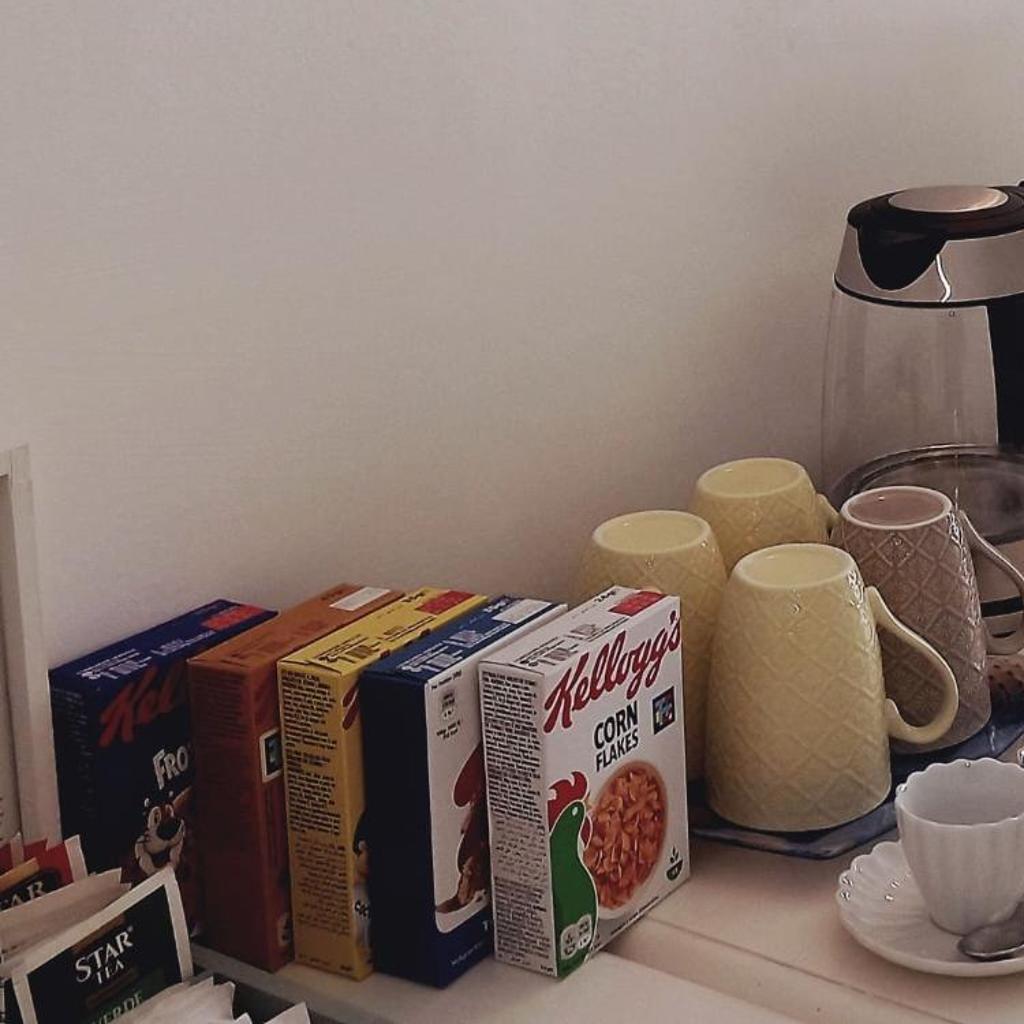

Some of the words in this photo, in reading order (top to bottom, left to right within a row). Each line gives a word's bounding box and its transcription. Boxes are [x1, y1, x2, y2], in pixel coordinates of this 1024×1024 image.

[543, 610, 681, 734] Kellogg's
[593, 701, 639, 750] CORN
[152, 742, 194, 790] FRO
[595, 728, 639, 772] FLAKES
[74, 930, 134, 983] STAR
[95, 960, 124, 985] TEA
